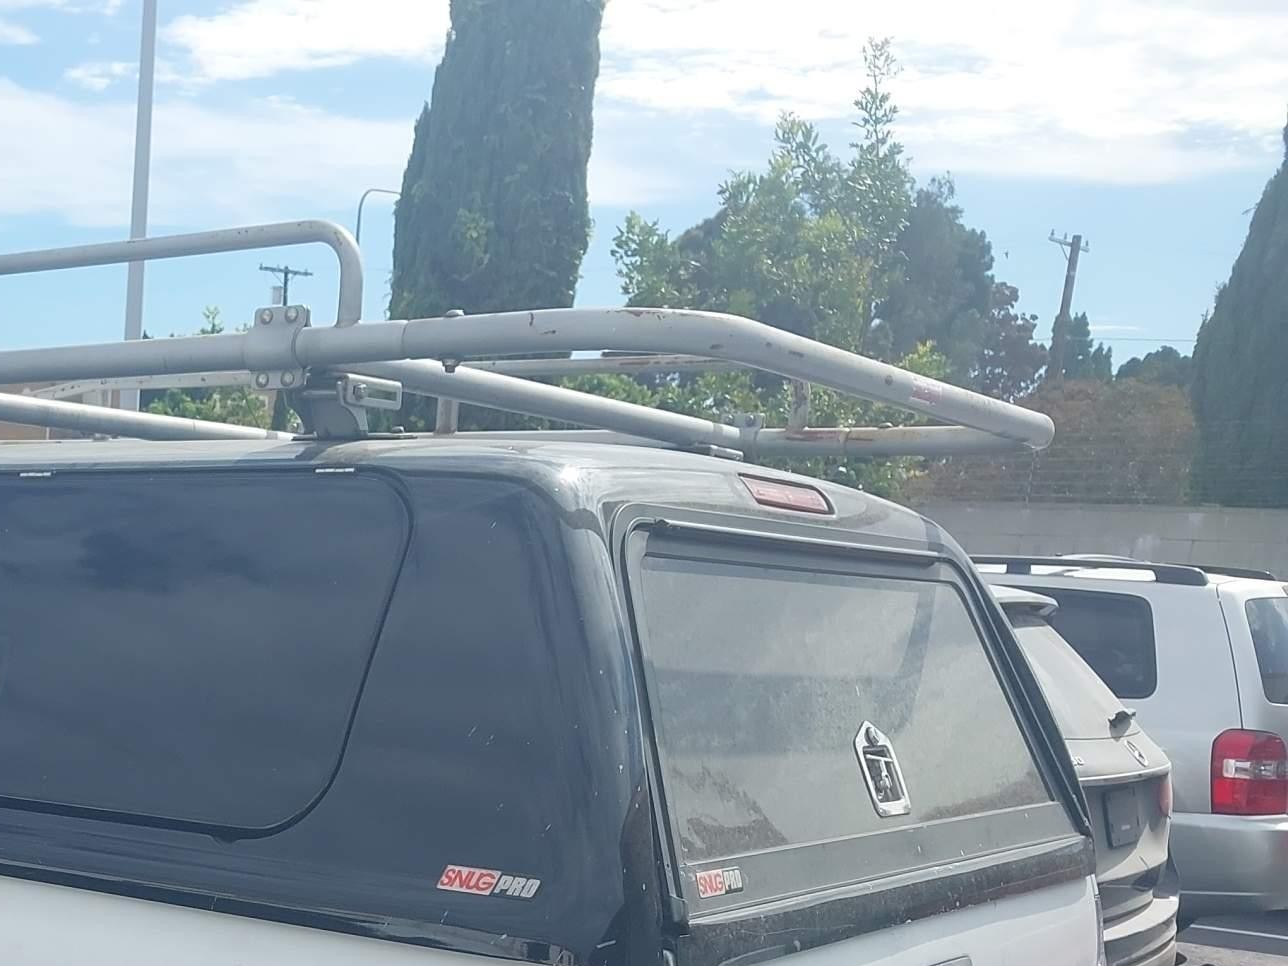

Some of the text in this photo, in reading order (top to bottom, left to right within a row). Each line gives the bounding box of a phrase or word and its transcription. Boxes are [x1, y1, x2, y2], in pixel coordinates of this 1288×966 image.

[438, 866, 541, 898] SNUG PRO
[697, 868, 743, 897] SNUG PRO
